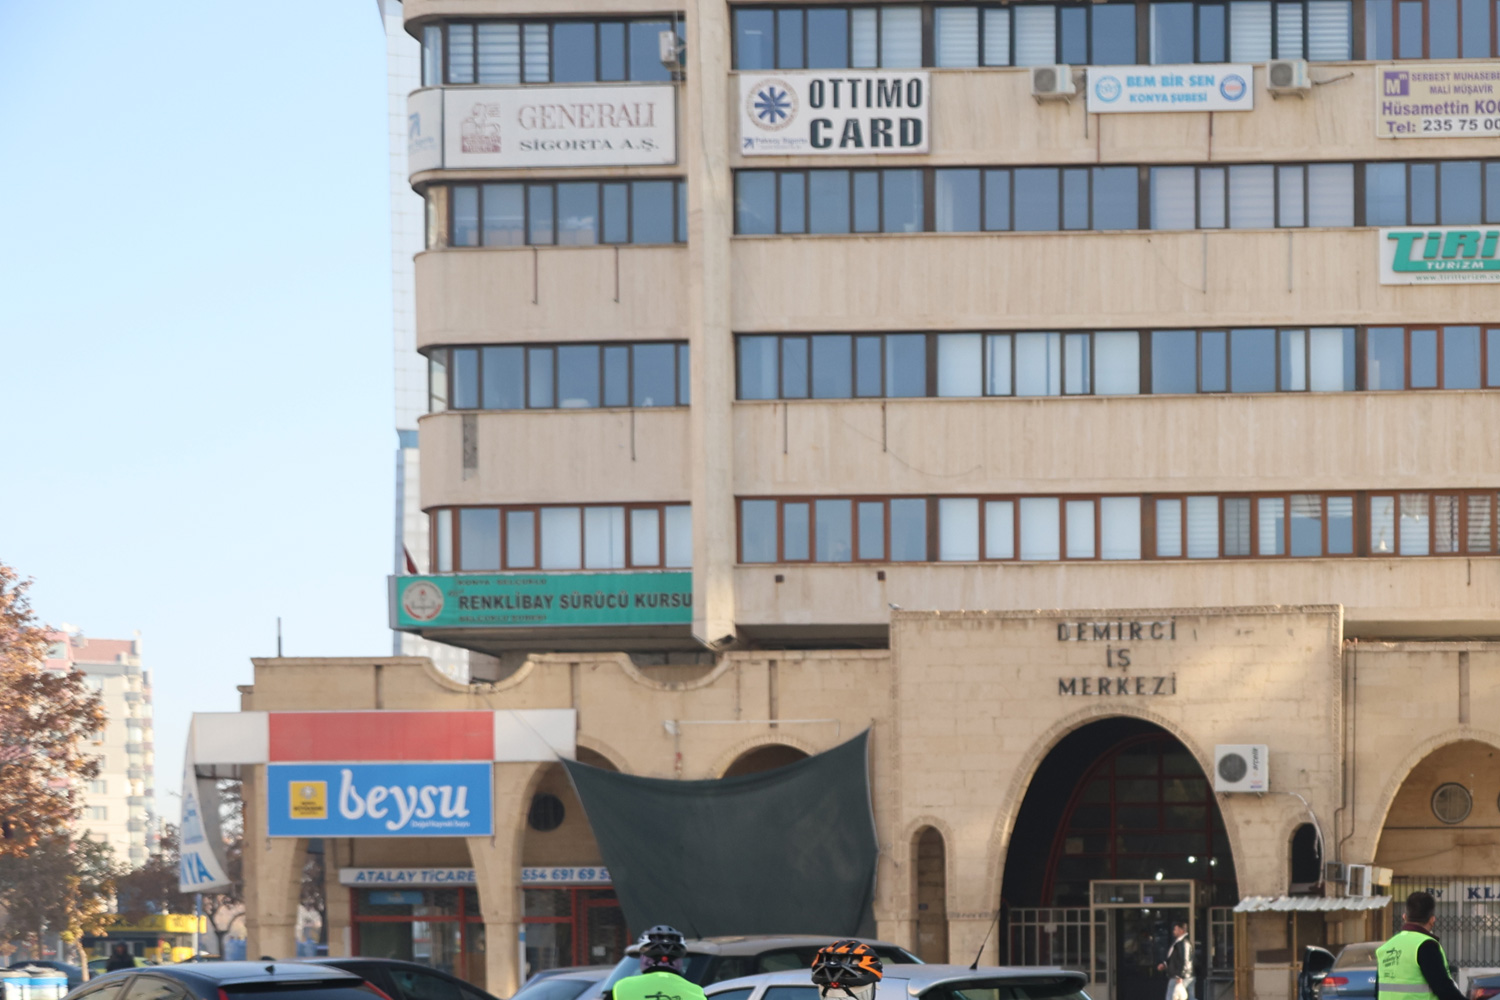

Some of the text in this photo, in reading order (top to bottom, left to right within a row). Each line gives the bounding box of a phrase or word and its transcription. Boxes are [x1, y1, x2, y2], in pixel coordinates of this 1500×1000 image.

[1126, 75, 1157, 87] BEM
[1189, 75, 1215, 87] SEN
[1412, 72, 1450, 81] SERBEST
[809, 78, 922, 109] OTTIMO
[1430, 84, 1493, 95] MALİ MÜŞAVİR
[1129, 93, 1168, 103] KONYA
[1382, 101, 1469, 115] Hüsamettin
[518, 102, 656, 130] GENERALI
[1387, 121, 1416, 133] Tel:
[1423, 119, 1453, 131] 235
[1459, 118, 1478, 131] 75
[810, 118, 922, 149] CARD
[520, 138, 613, 151] SİGORTA
[458, 592, 554, 610] RENKLİBAY
[559, 590, 629, 609] SÜRÜCÜ
[635, 591, 692, 608] KURSU
[1057, 616, 1176, 641] DEMİRCİ
[1106, 644, 1131, 672] İŞ
[1059, 672, 1176, 696] MERKEZİ
[338, 769, 470, 831] beysu
[355, 868, 476, 882] ATALAY TİCARE
[552, 868, 574, 879] 691
[579, 868, 596, 879] 69
